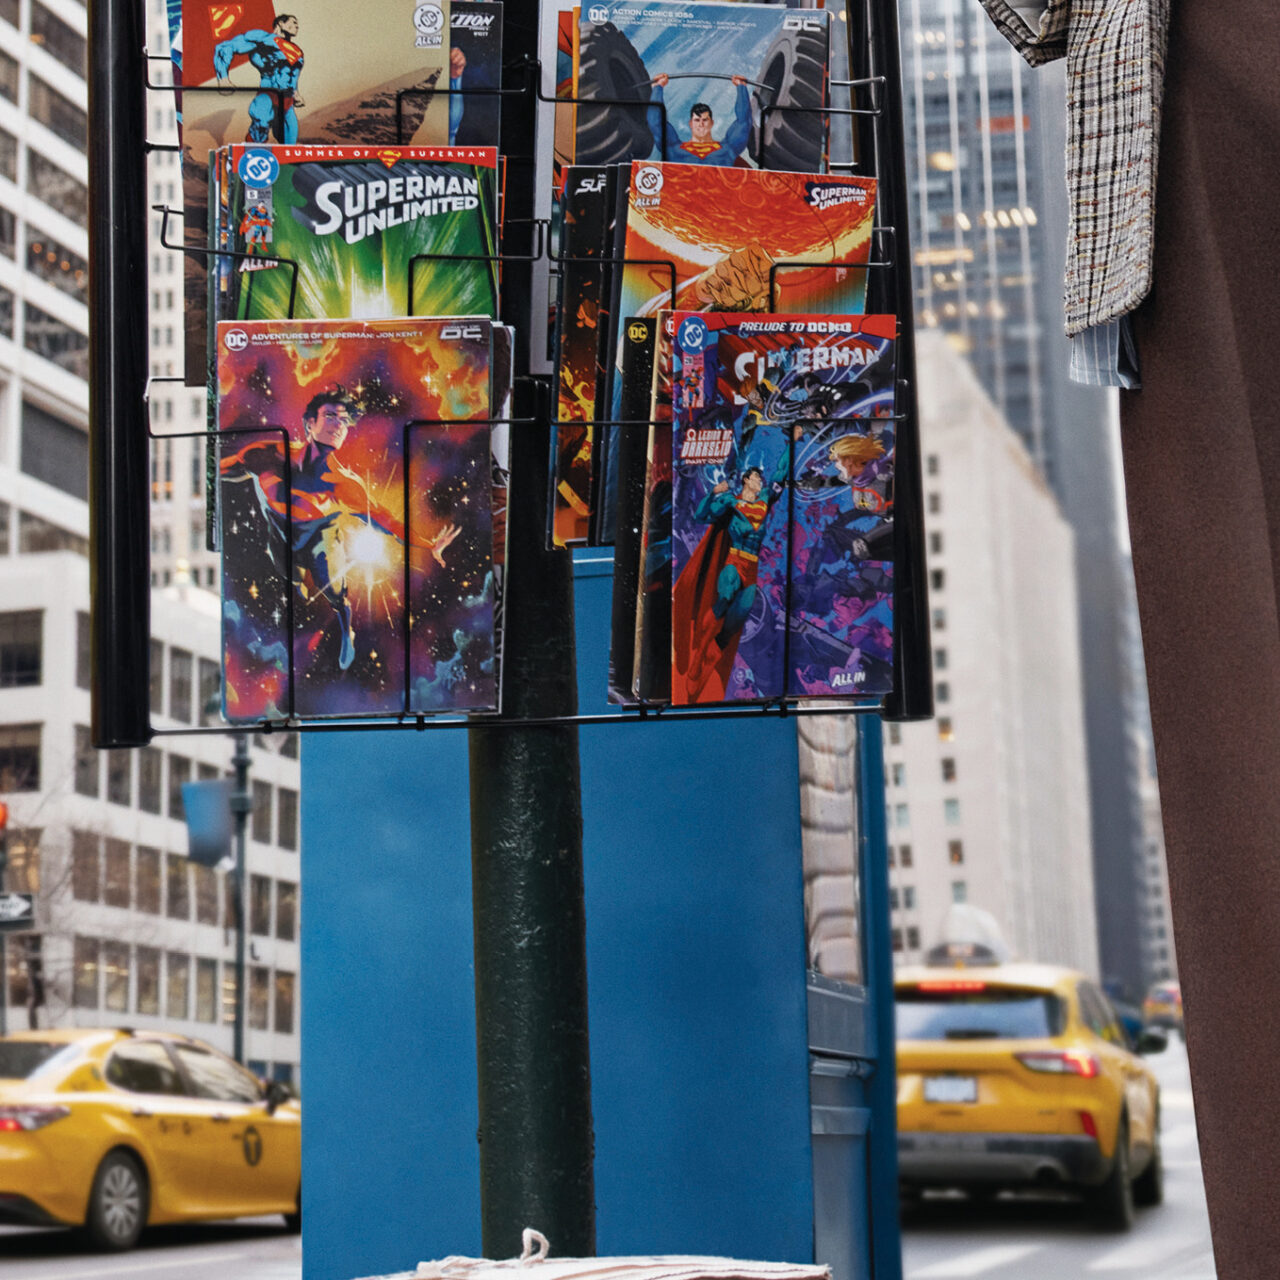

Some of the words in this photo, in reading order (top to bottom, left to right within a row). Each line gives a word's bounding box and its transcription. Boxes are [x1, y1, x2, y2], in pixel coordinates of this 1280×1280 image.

[451, 13, 495, 27] CTION
[589, 9, 609, 21] DC
[612, 8, 642, 17] ACTION
[643, 10, 674, 18] COMICS
[415, 36, 432, 47] ALL
[432, 35, 442, 45] IN
[285, 150, 344, 158] SUMMER
[353, 150, 370, 158] OF
[410, 150, 486, 158] SUPERMAN
[248, 162, 270, 179] DC
[643, 174, 657, 189] DC
[634, 198, 652, 208] ALL
[652, 197, 661, 206] IN
[809, 186, 868, 207] SUPERMAN
[819, 195, 867, 210] UNLIMITED
[315, 175, 479, 236] SUPERMAN
[345, 195, 479, 245] UNLIMITED
[240, 258, 262, 272] ALL
[629, 326, 647, 339] DC
[739, 322, 787, 333] PRELUDE
[789, 322, 805, 333] TO
[226, 333, 248, 348] DC
[251, 332, 309, 341] ADVENTURES
[310, 331, 322, 340] OF
[376, 331, 393, 339] JON
[395, 331, 418, 339] KENT
[685, 326, 703, 344] DC
[681, 439, 733, 459] DARKSEID
[831, 673, 854, 687] ALL
[853, 671, 866, 684] IN
